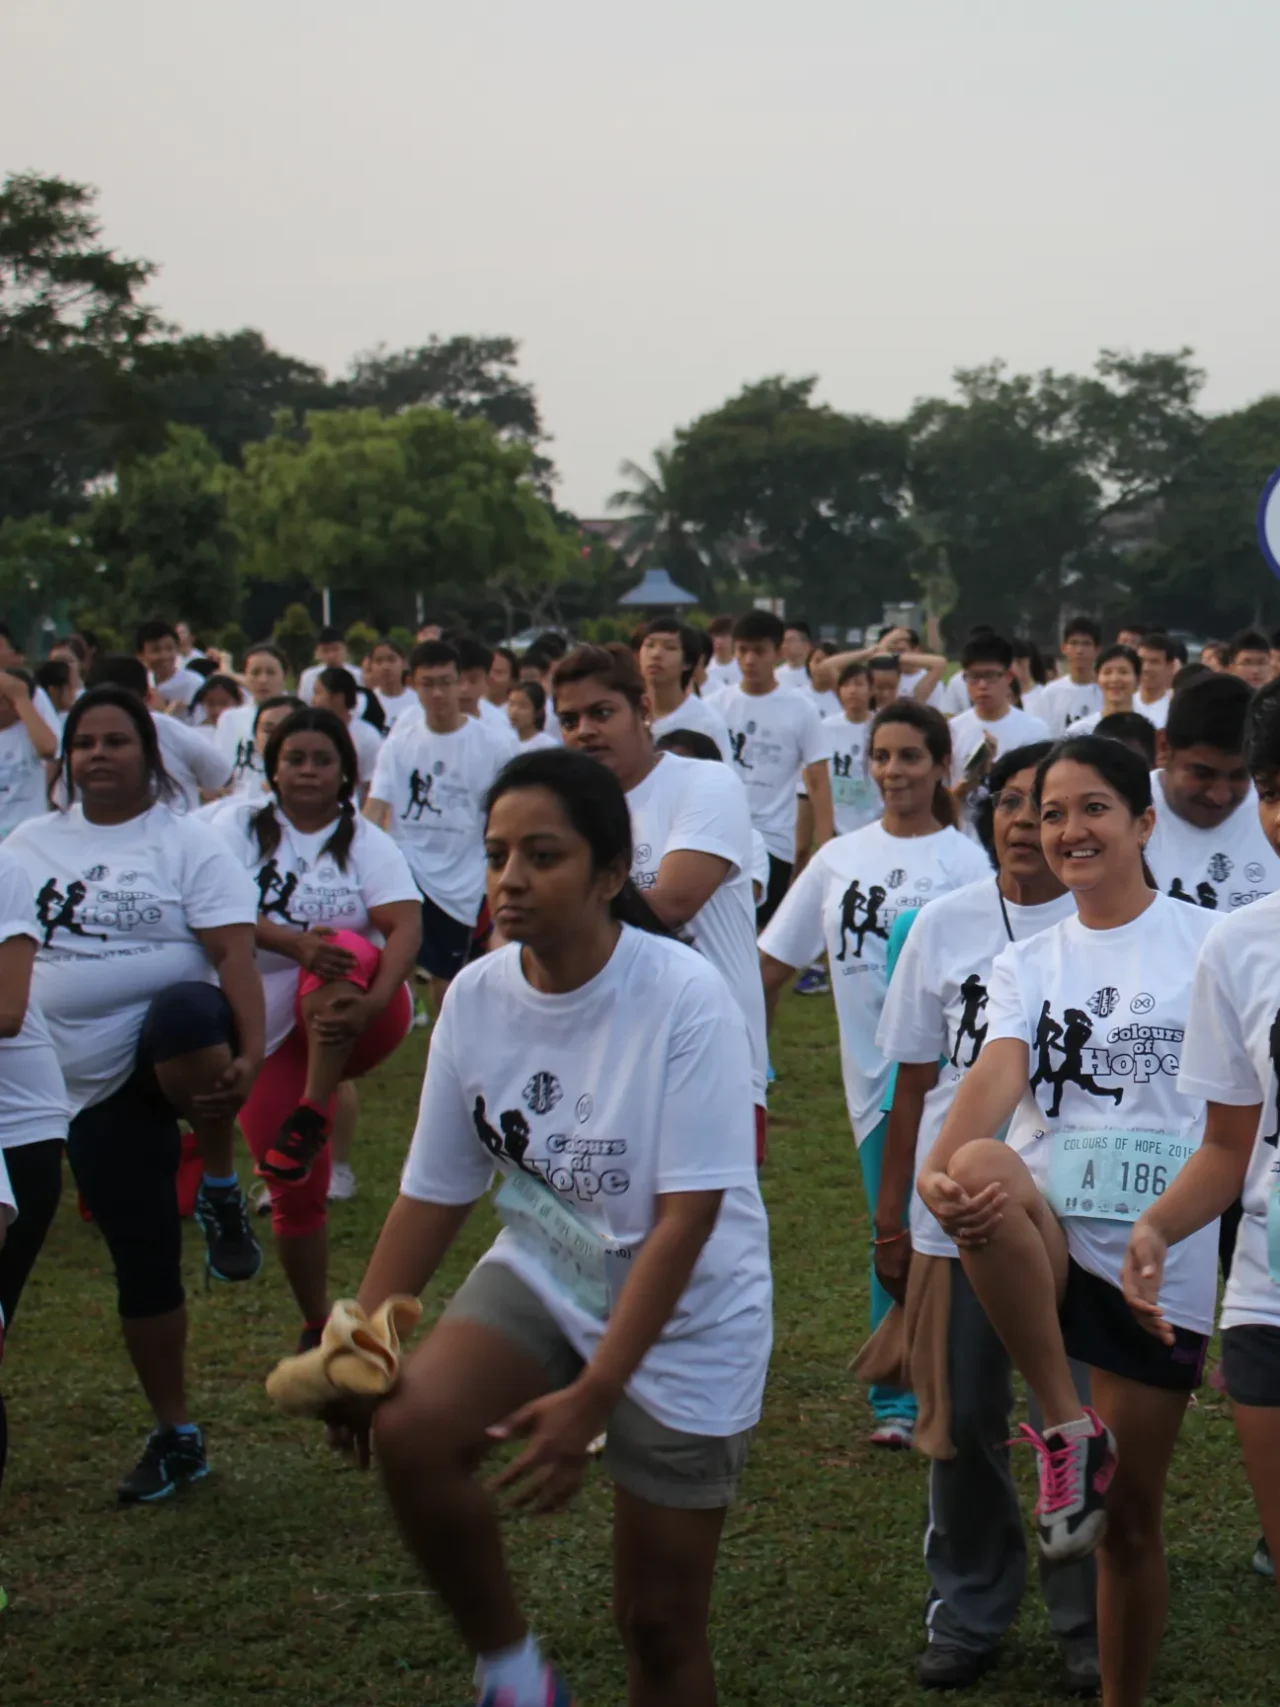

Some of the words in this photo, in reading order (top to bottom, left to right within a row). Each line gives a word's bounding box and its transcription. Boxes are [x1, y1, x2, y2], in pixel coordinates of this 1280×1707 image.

[1107, 1023, 1185, 1043] Colours
[1133, 1040, 1155, 1055] of
[1080, 1048, 1180, 1083] Hope
[1064, 1137, 1108, 1151] COLOURS
[1115, 1138, 1129, 1151] OF
[1135, 1140, 1162, 1155] HOPE
[571, 1156, 592, 1173] of
[1081, 1159, 1095, 1190] A
[1121, 1161, 1168, 1196] 186
